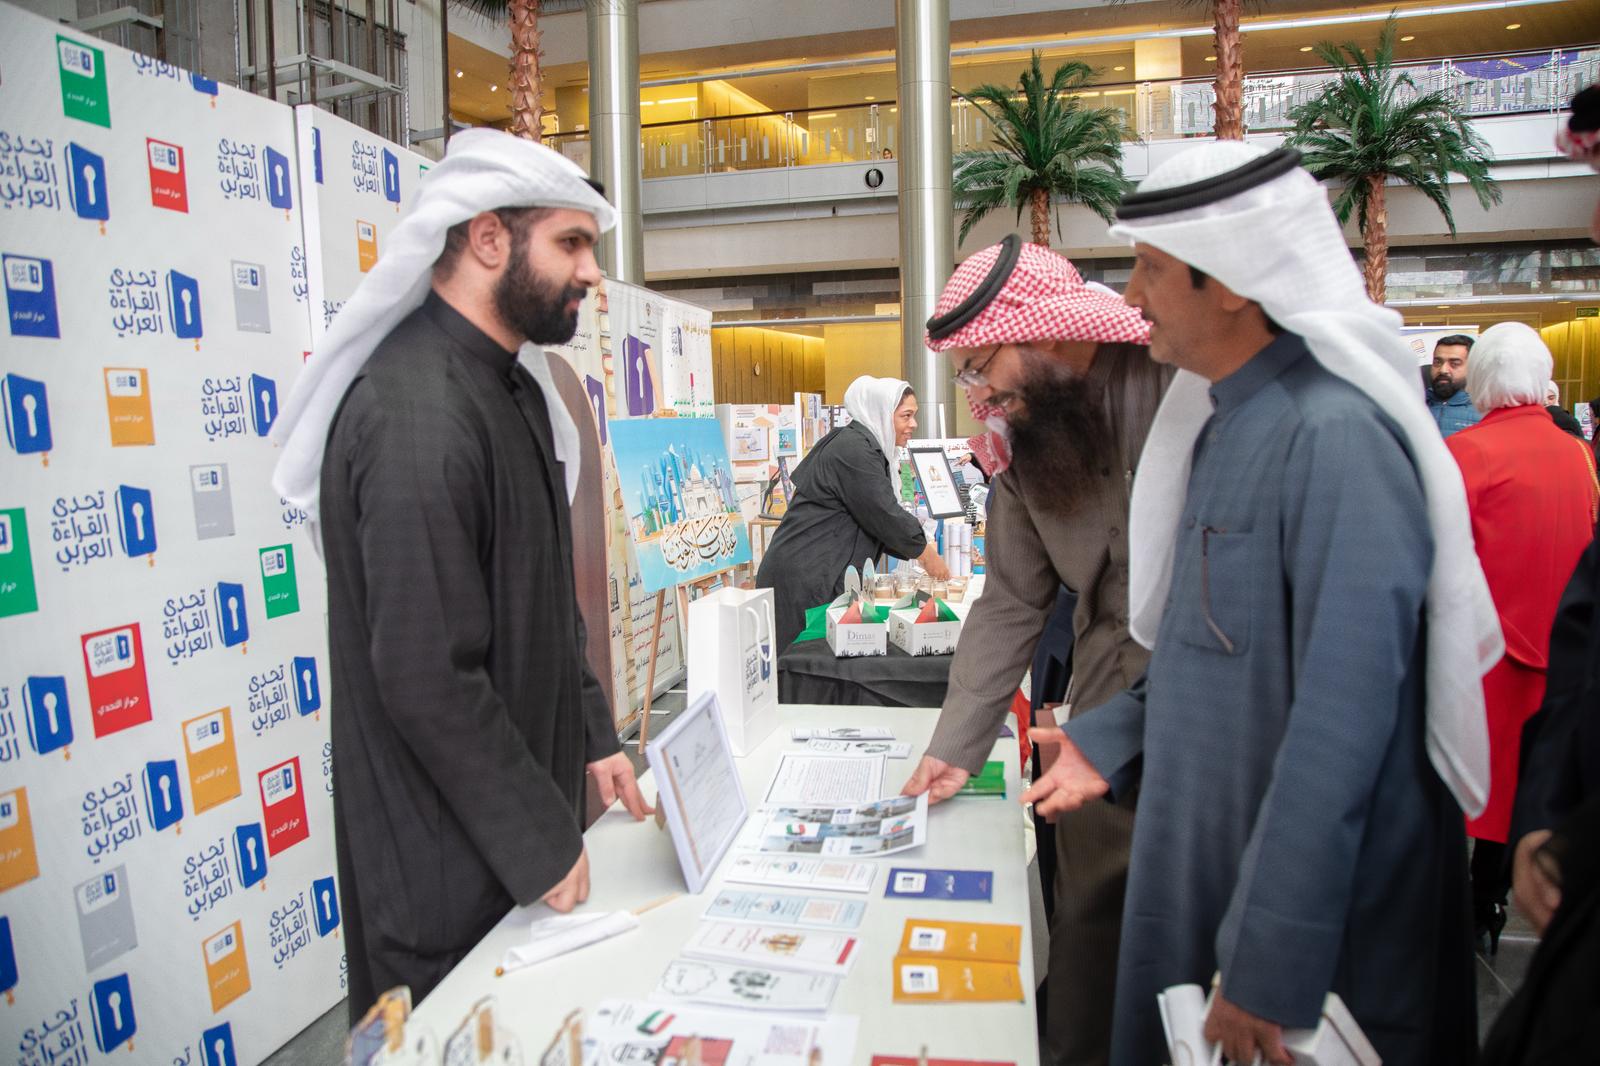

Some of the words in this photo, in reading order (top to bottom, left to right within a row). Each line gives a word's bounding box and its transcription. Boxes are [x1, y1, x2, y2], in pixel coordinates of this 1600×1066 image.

[218, 138, 256, 159] تحدي
[352, 140, 377, 158] تحدي
[218, 156, 259, 181] القراءة
[352, 155, 379, 178] القراءة
[0, 181, 61, 211] العربي
[220, 179, 261, 200] العربي
[353, 175, 380, 195] العربي
[110, 268, 157, 292] تحدي
[109, 289, 161, 314] القراءة
[113, 314, 164, 337] العربي
[202, 376, 241, 399] تحدي
[201, 396, 245, 419] القراءة
[204, 416, 247, 441] العربي
[52, 491, 104, 524] تحدي
[52, 513, 109, 543] القراءة
[56, 537, 113, 572] العربي
[163, 589, 206, 622] تحدي
[163, 609, 210, 639] القراءة
[167, 631, 213, 665] العربي
[249, 664, 285, 698] تحدي
[248, 683, 288, 713] القراءة
[252, 703, 291, 736] العربي
[82, 773, 133, 818] تحدي
[82, 795, 138, 836] القراءة
[87, 818, 142, 864] العربي
[184, 837, 225, 879] تحدي
[183, 857, 229, 896] القراءة
[188, 878, 233, 921] العربي
[269, 892, 304, 932] تحدي
[269, 909, 308, 947] القراءة
[273, 929, 311, 969] العربي
[19, 998, 78, 1058] تحدي
